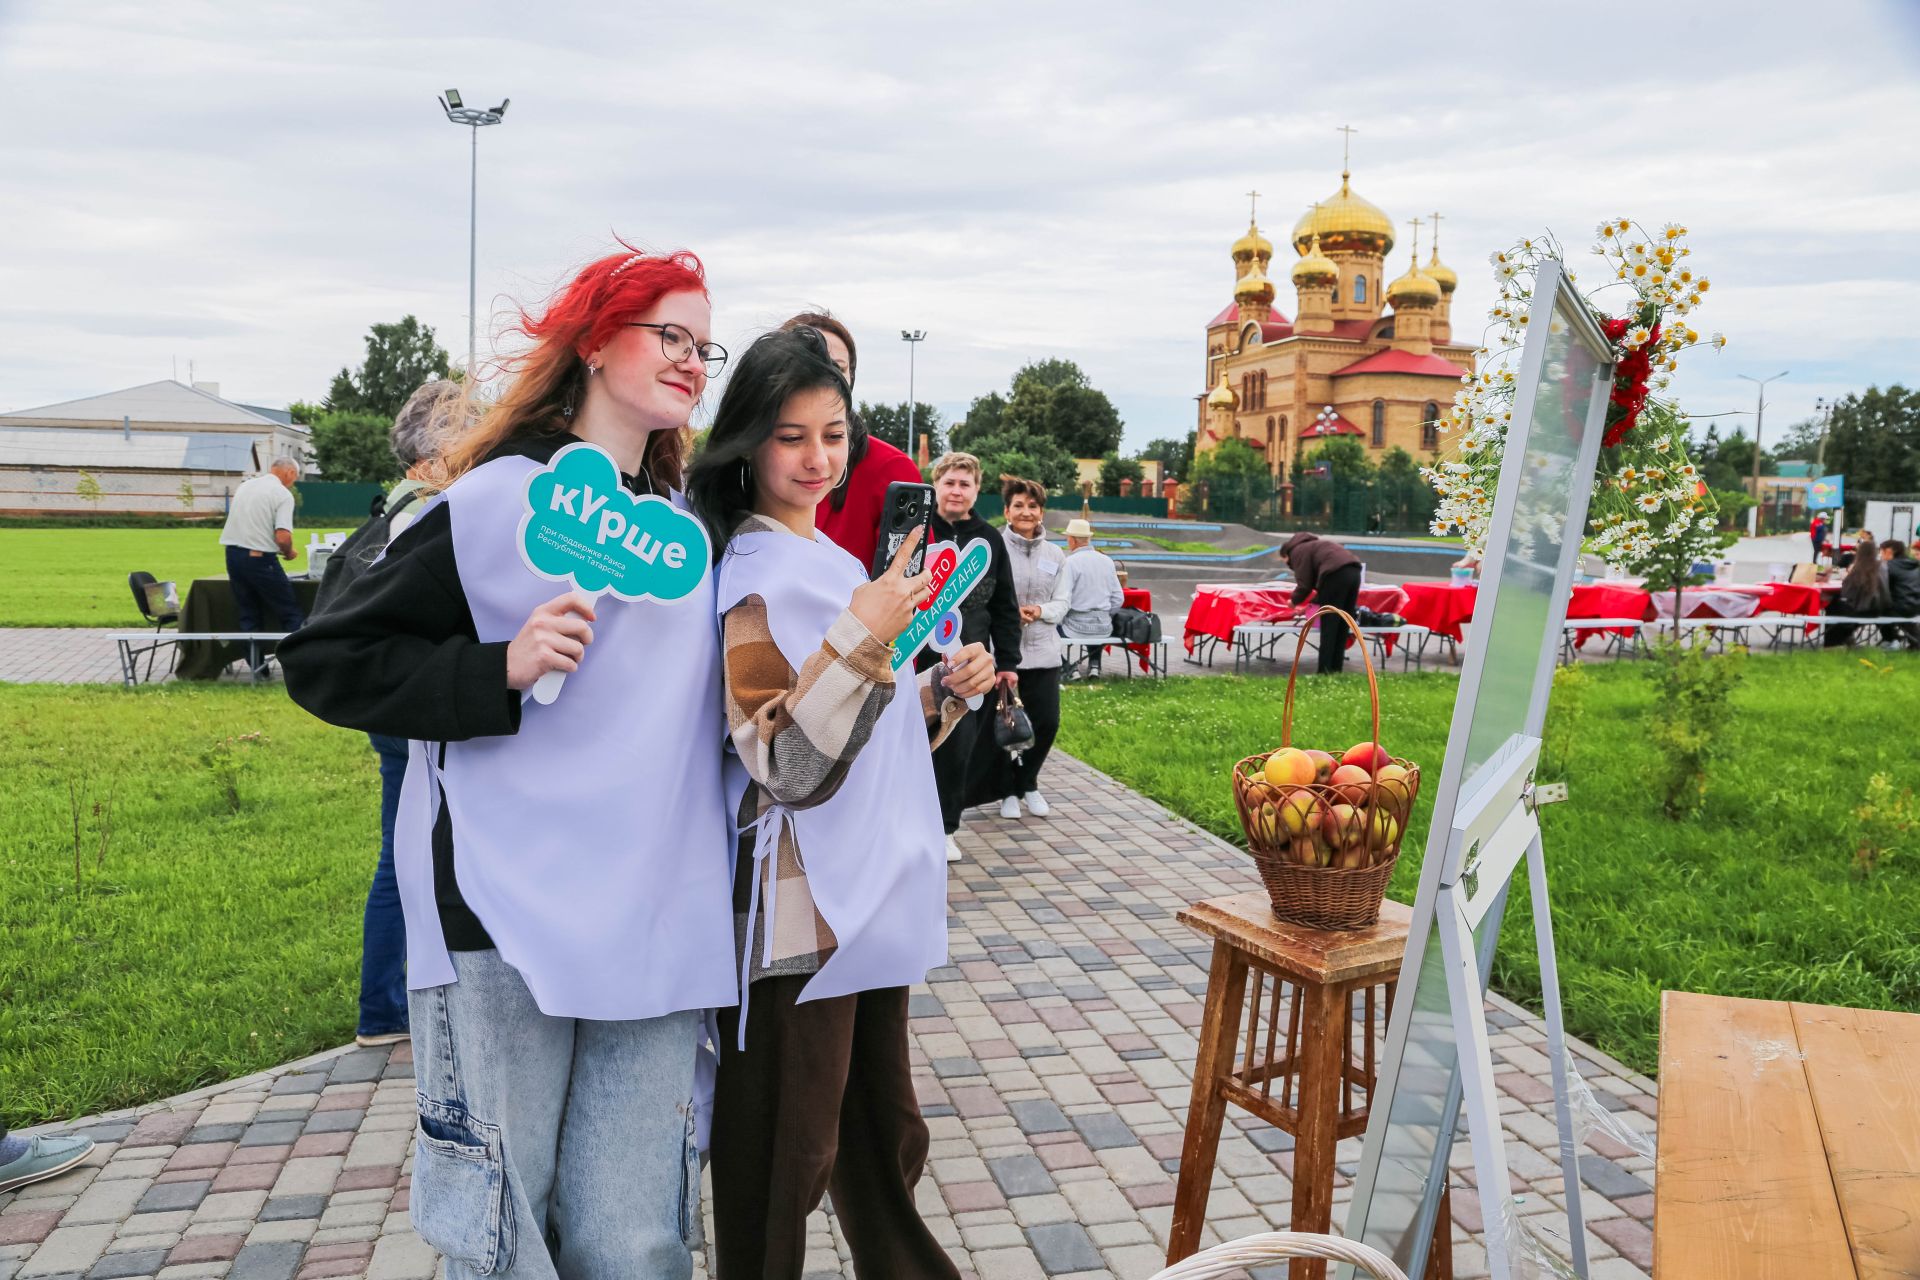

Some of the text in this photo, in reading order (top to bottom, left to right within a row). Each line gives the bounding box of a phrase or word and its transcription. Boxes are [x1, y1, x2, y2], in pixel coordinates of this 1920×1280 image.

[537, 532, 624, 579] Республики Татарстан
[540, 525, 626, 571] при поддержке Раиса
[893, 555, 980, 663] В ТАТАРСТАНЕ
